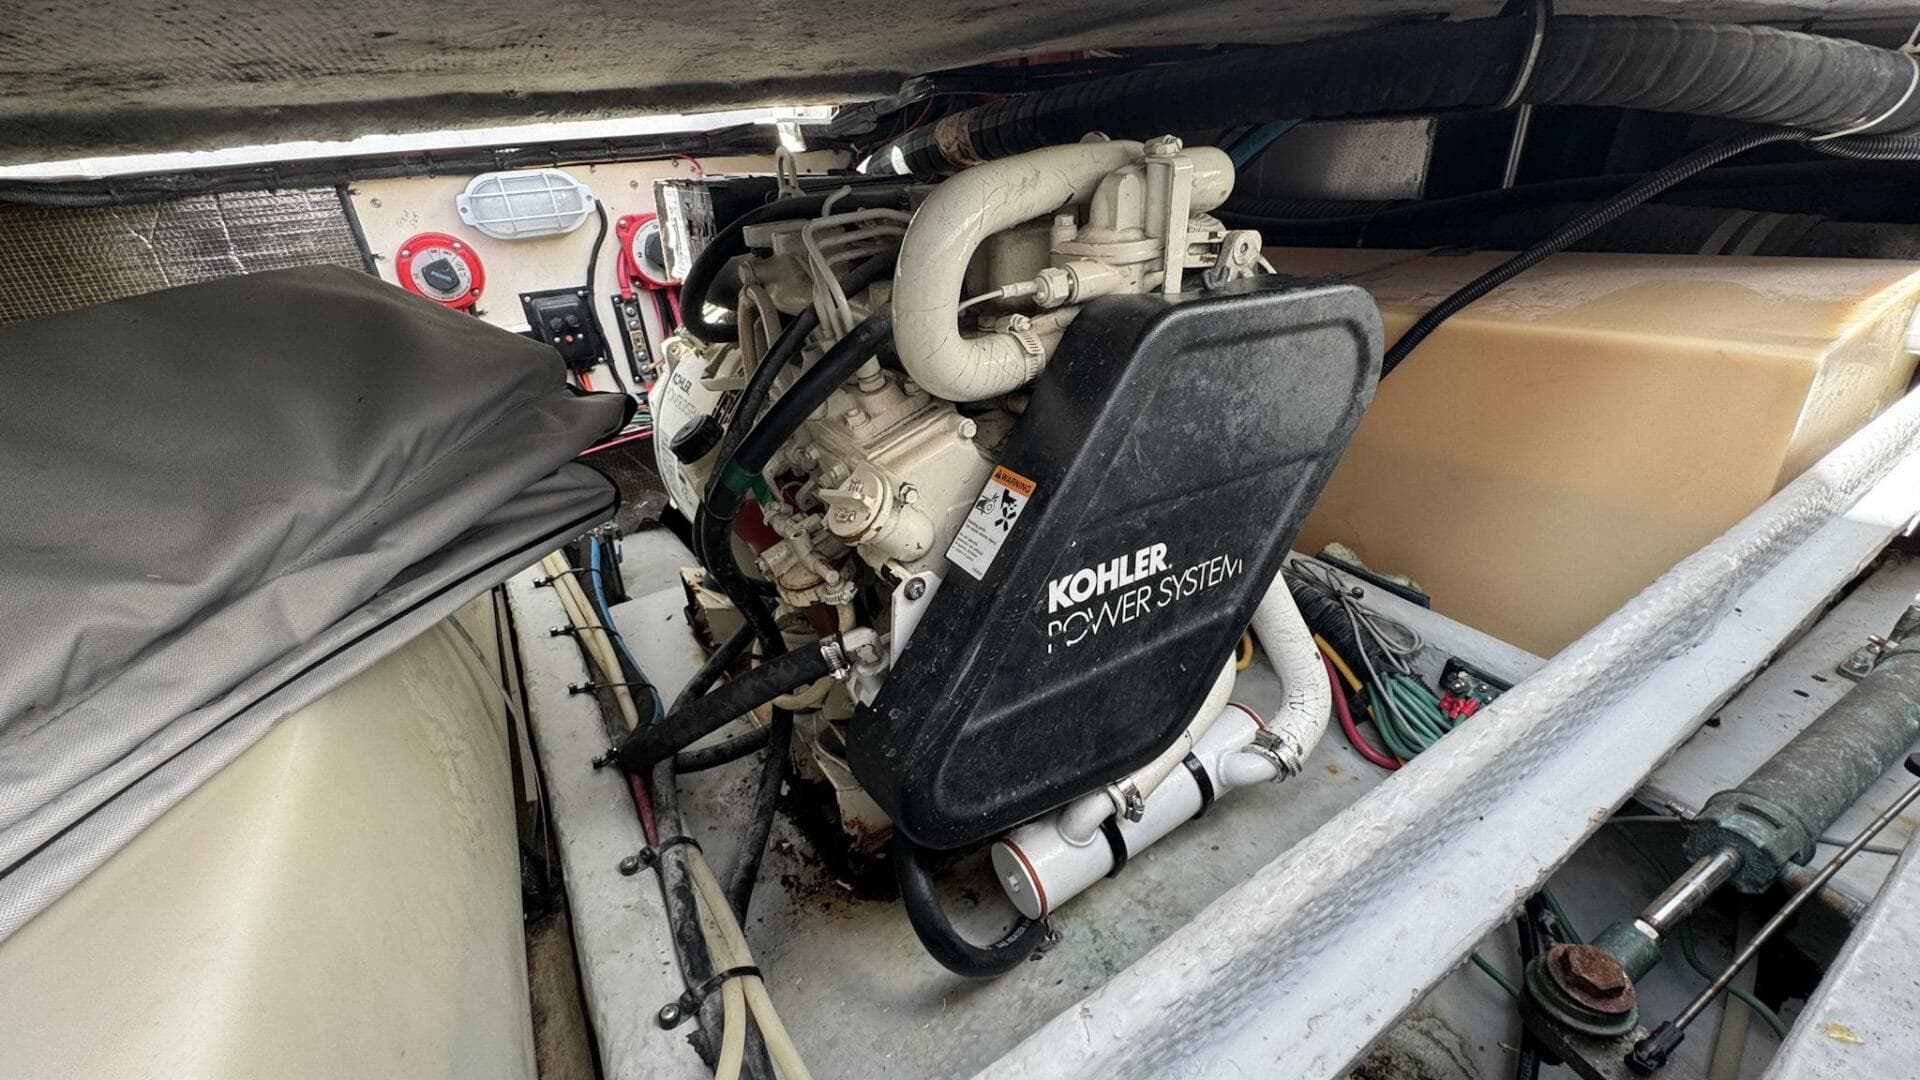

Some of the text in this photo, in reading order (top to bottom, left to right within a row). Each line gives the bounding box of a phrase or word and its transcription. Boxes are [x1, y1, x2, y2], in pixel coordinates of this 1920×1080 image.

[672, 372, 692, 396] KOHLER
[1001, 473, 1032, 494] WARNING
[1048, 585, 1152, 654] POWER
